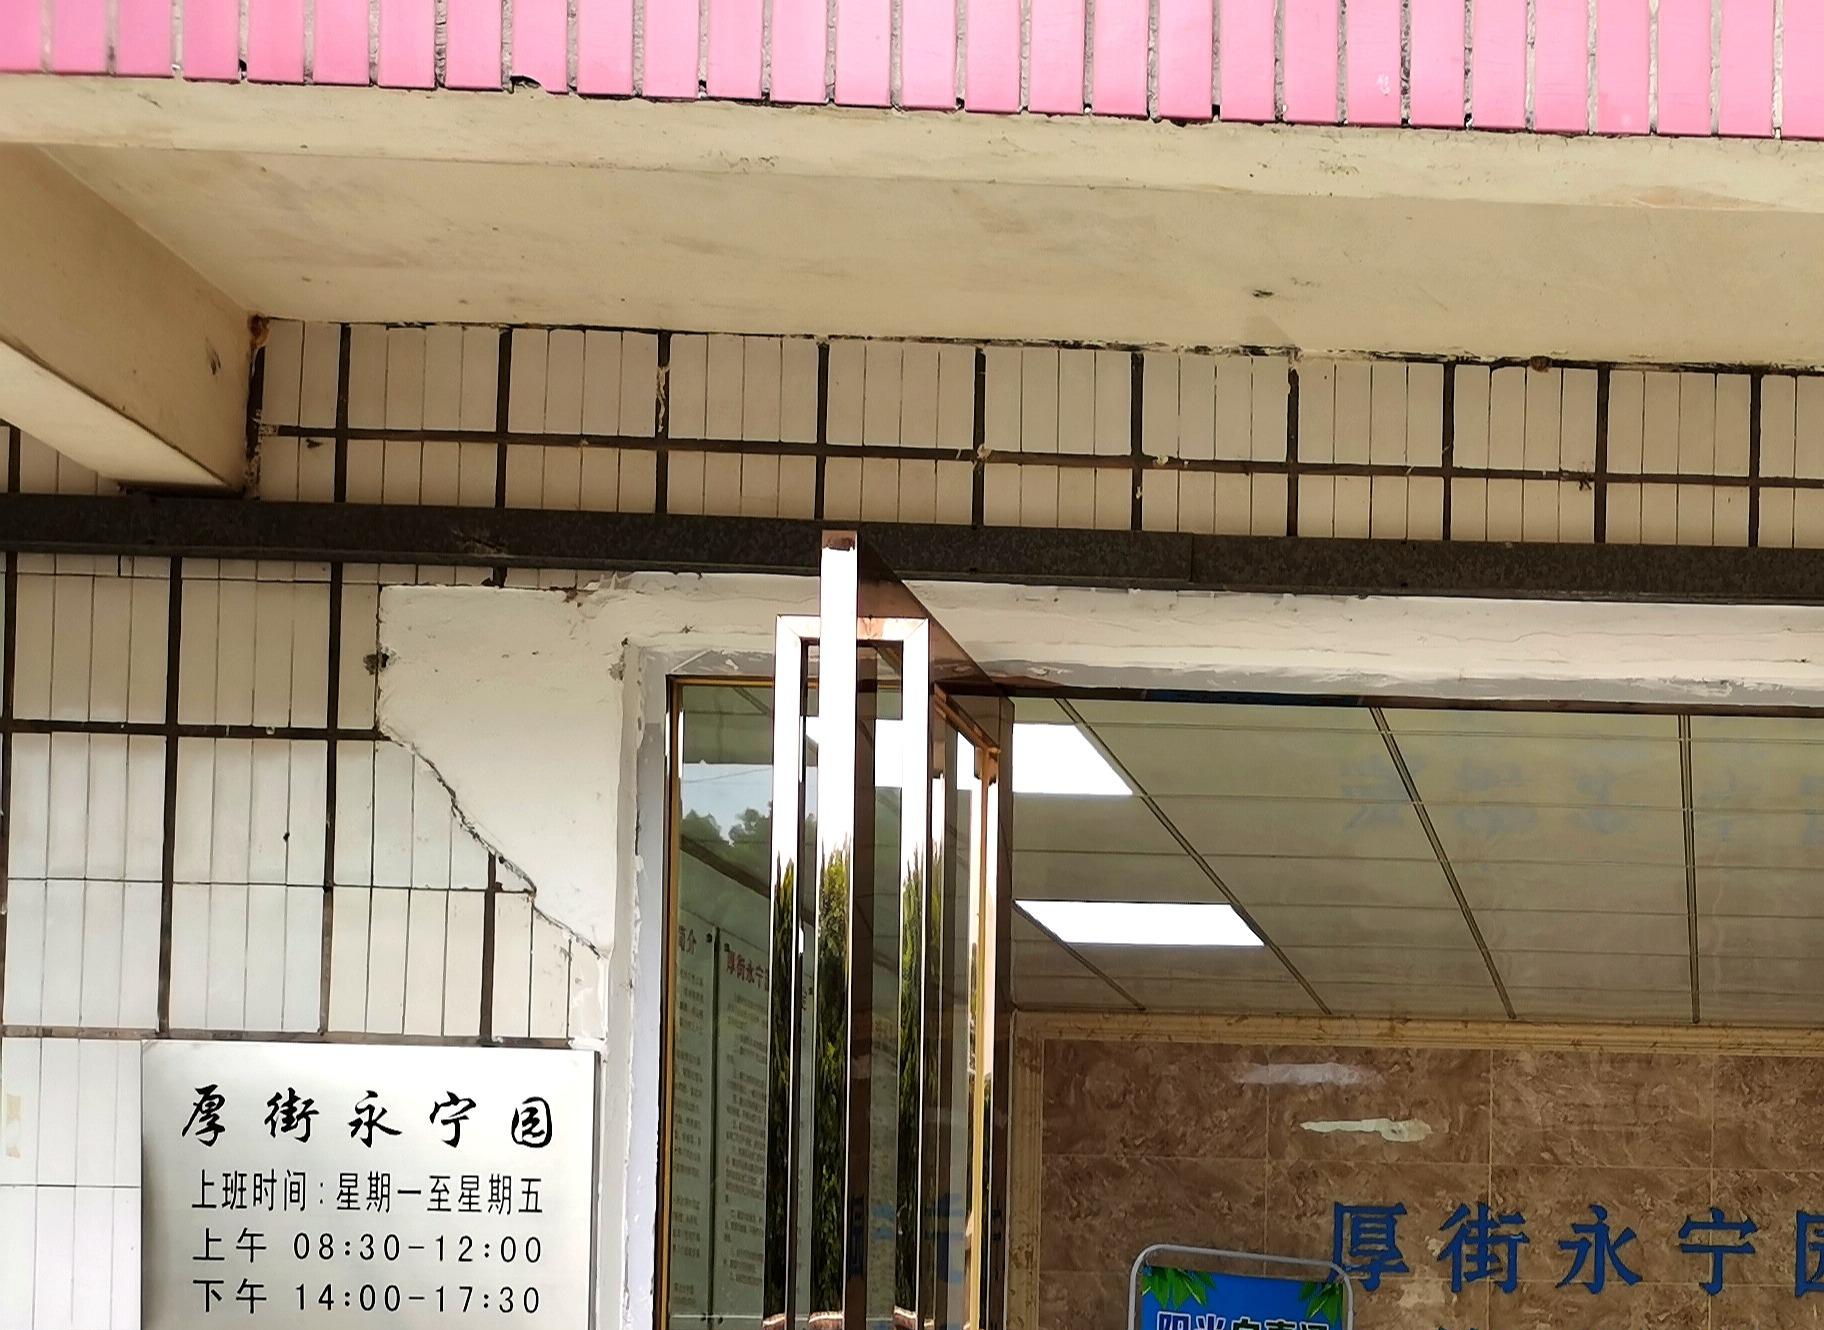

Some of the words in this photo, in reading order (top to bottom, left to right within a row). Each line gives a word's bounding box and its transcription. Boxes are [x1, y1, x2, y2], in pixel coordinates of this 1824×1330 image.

[182, 1083, 553, 1149] 厚街永宁园
[191, 1168, 543, 1216] 上班时间:星期一至星期五
[192, 1227, 268, 1263] 上午
[293, 1233, 543, 1263] 08:30-12:00
[192, 1278, 268, 1315] 下午
[295, 1284, 541, 1314] 14:00-17:30
